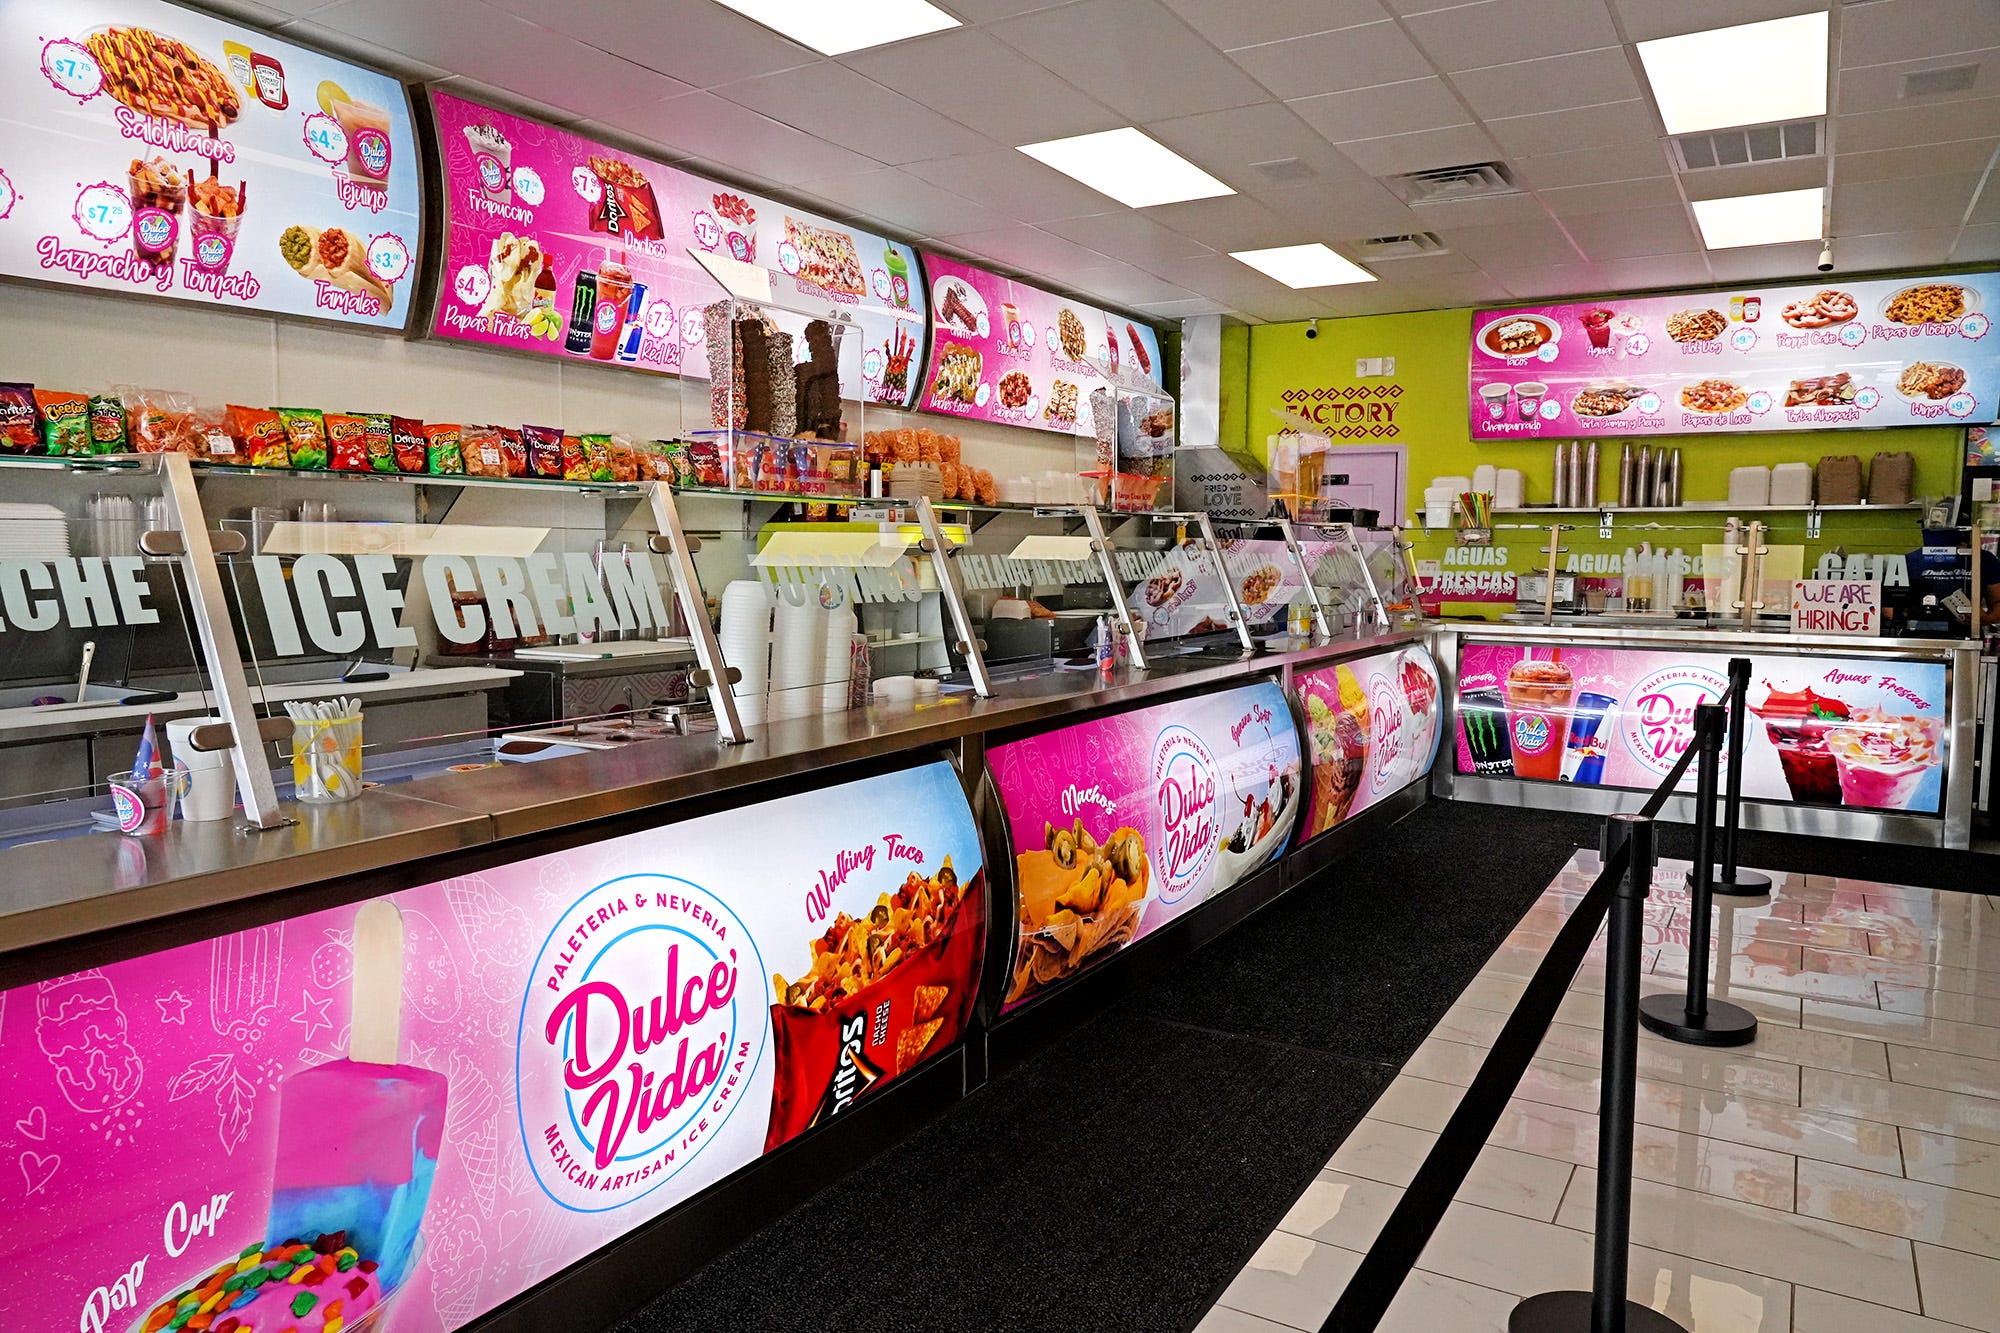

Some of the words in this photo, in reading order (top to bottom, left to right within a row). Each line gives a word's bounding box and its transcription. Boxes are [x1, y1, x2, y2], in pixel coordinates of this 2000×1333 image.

[55, 59, 91, 80] $7.75
[115, 106, 235, 164] Salchitacos
[310, 129, 343, 151] $4.25
[332, 170, 389, 214] Tejuino
[87, 205, 123, 225] $7.25
[467, 187, 534, 228] Frapuccino
[604, 183, 620, 233] Doritos
[155, 264, 175, 293] y
[180, 257, 261, 300] Tornado
[314, 279, 380, 315] Tamales
[443, 304, 489, 335] Papas
[492, 312, 532, 341] Fritas
[1872, 324, 1908, 341] Papas
[640, 338, 661, 365] Red
[1586, 345, 1616, 359] Aguas
[1681, 340, 1700, 355] Hot
[1700, 340, 1723, 355] Dog
[1504, 354, 1529, 367] Tacos
[45, 401, 88, 422] Cheetos
[1681, 413, 1712, 428] Papas
[1713, 412, 1729, 426] de
[1728, 412, 1753, 426] Luxe
[1784, 409, 1812, 423] Torta
[1813, 408, 1860, 423] Ahogada
[1910, 401, 1945, 418] Wings
[331, 422, 365, 440] Cheetos
[1481, 419, 1542, 433] Champurrado
[394, 434, 425, 446] Doritos
[500, 439, 526, 452] Doritos
[533, 441, 560, 452] Doritos
[759, 480, 786, 492] $1.50
[788, 481, 796, 492] &
[1204, 484, 1228, 493] FRIED
[1203, 493, 1242, 506] LOVE
[1443, 546, 1508, 566] AGUAS
[1432, 570, 1516, 591] FRESCAS
[0, 556, 160, 633] CHE
[251, 553, 418, 657] ICE
[422, 551, 670, 645] CREAM
[1803, 584, 1836, 604] WE
[1838, 584, 1873, 605] ARE
[1798, 609, 1870, 631] HIRING!
[1459, 673, 1498, 688] Monster
[1577, 675, 1598, 687] Red
[1602, 674, 1625, 689] Bull
[1642, 672, 1687, 693] PALETERIA
[1702, 674, 1729, 691] NEVE
[1823, 668, 1872, 685] Aguas
[1878, 676, 1932, 710] Frescas
[1569, 732, 1590, 745] Red
[1630, 731, 1657, 764] MEXICAN
[1157, 736, 1176, 780] PALETERIA
[1183, 737, 1210, 766] NEVERIA
[1061, 783, 1117, 816] Nachos
[1158, 847, 1170, 889] MEXICAN
[1168, 876, 1191, 893] ARTISAN
[1191, 864, 1203, 881] ICE
[1203, 823, 1220, 863] CREAM
[805, 844, 877, 923] Walking
[882, 833, 925, 866] Taco
[546, 898, 629, 992] PALETERIA
[634, 893, 648, 908] &
[656, 892, 727, 942] NEVERIA
[871, 1005, 883, 1047] NACHO
[878, 1000, 891, 1045] CHEESE
[543, 1123, 599, 1191] MEXICAN
[600, 1149, 676, 1192] ARTISAN
[682, 1118, 709, 1150] ICE
[712, 1040, 750, 1113] CREAM
[79, 1253, 150, 1333] Pop
[163, 1190, 234, 1257] Cup
